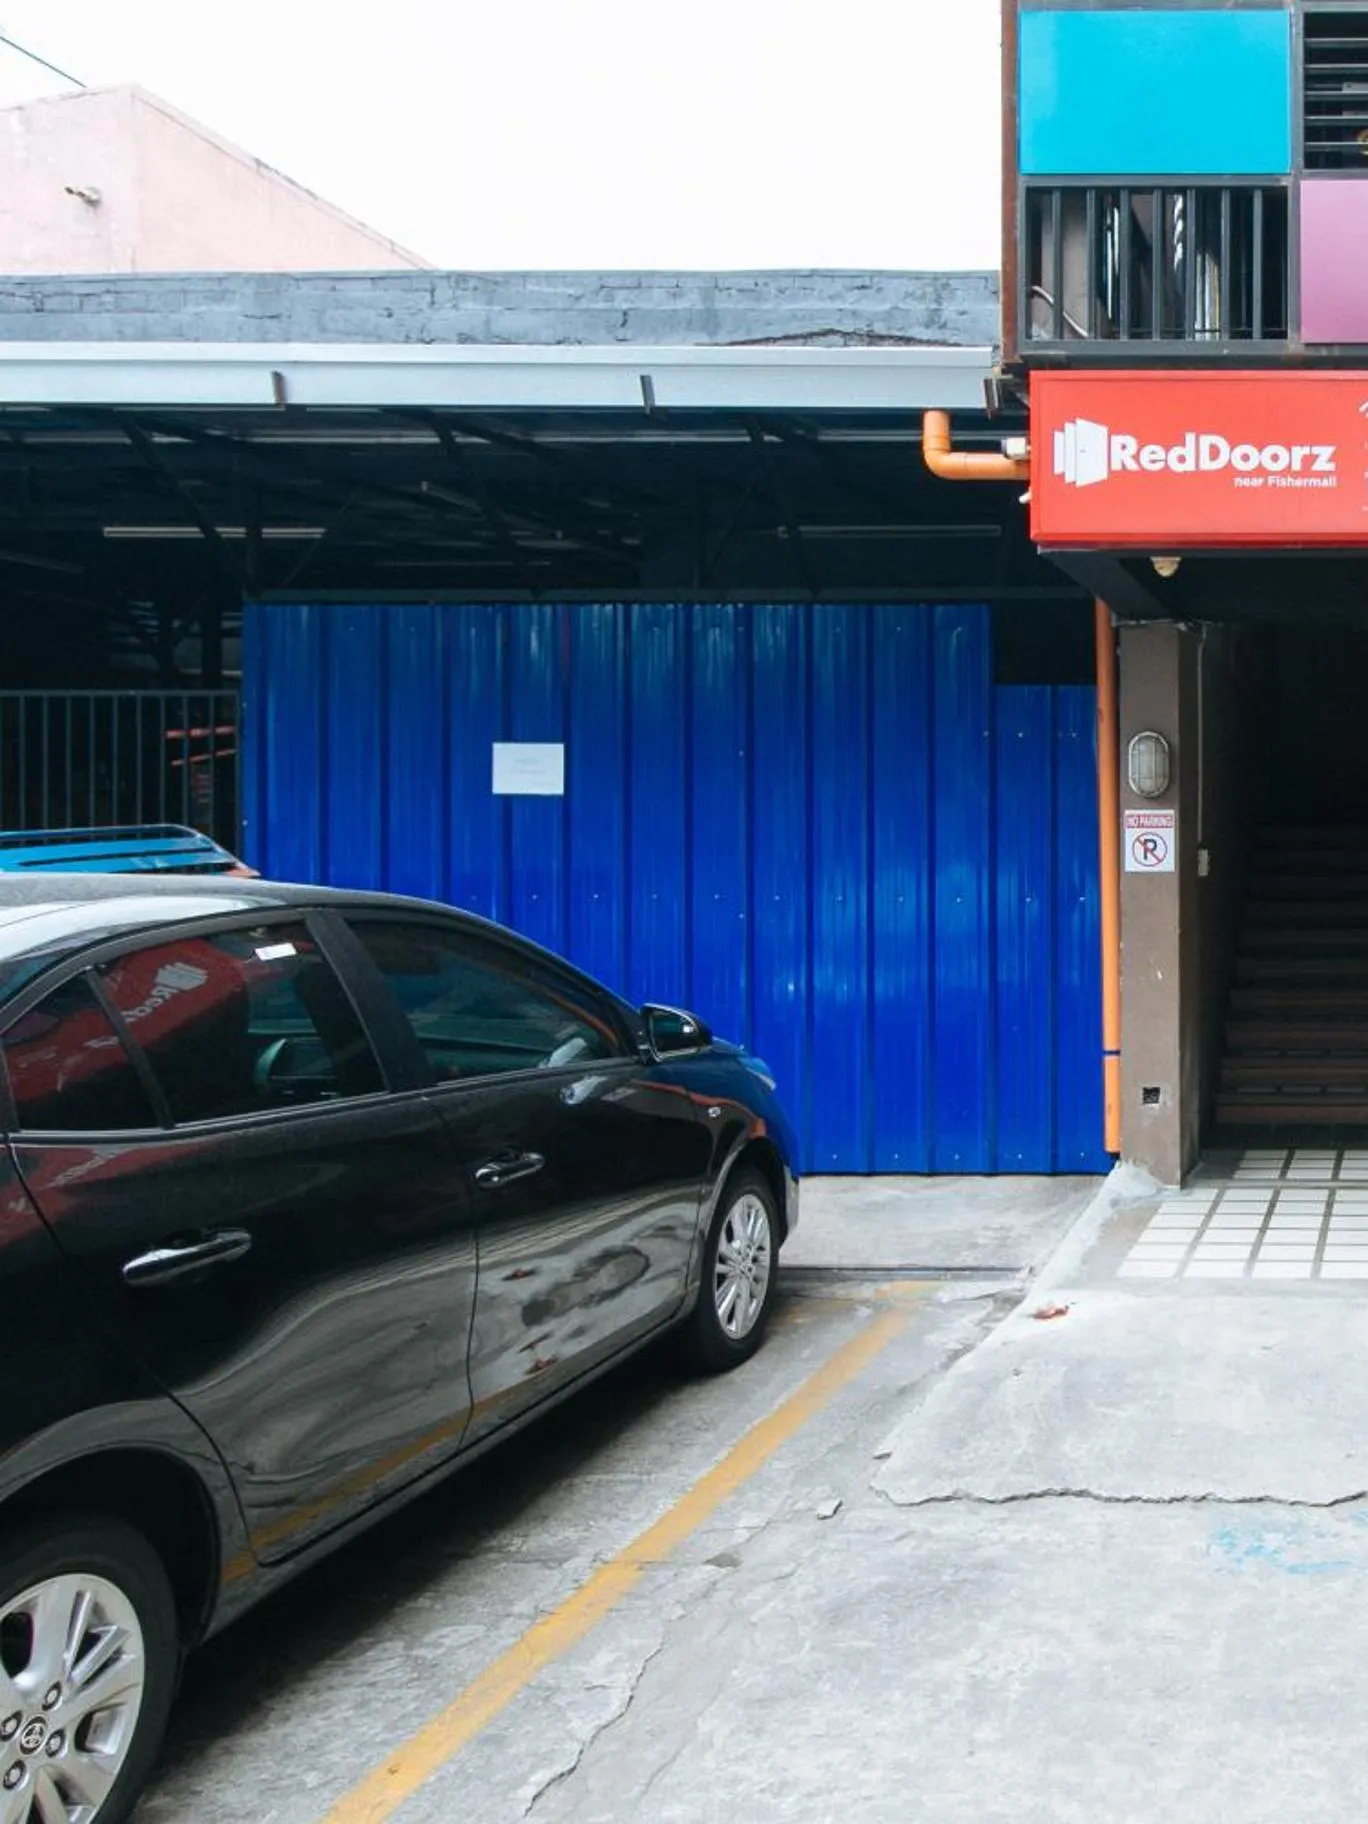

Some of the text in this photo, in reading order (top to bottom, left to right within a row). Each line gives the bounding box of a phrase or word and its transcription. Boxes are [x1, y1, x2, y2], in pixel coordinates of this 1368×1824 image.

[1110, 432, 1337, 473] RedDoorz
[1234, 475, 1337, 488] near Fishermall
